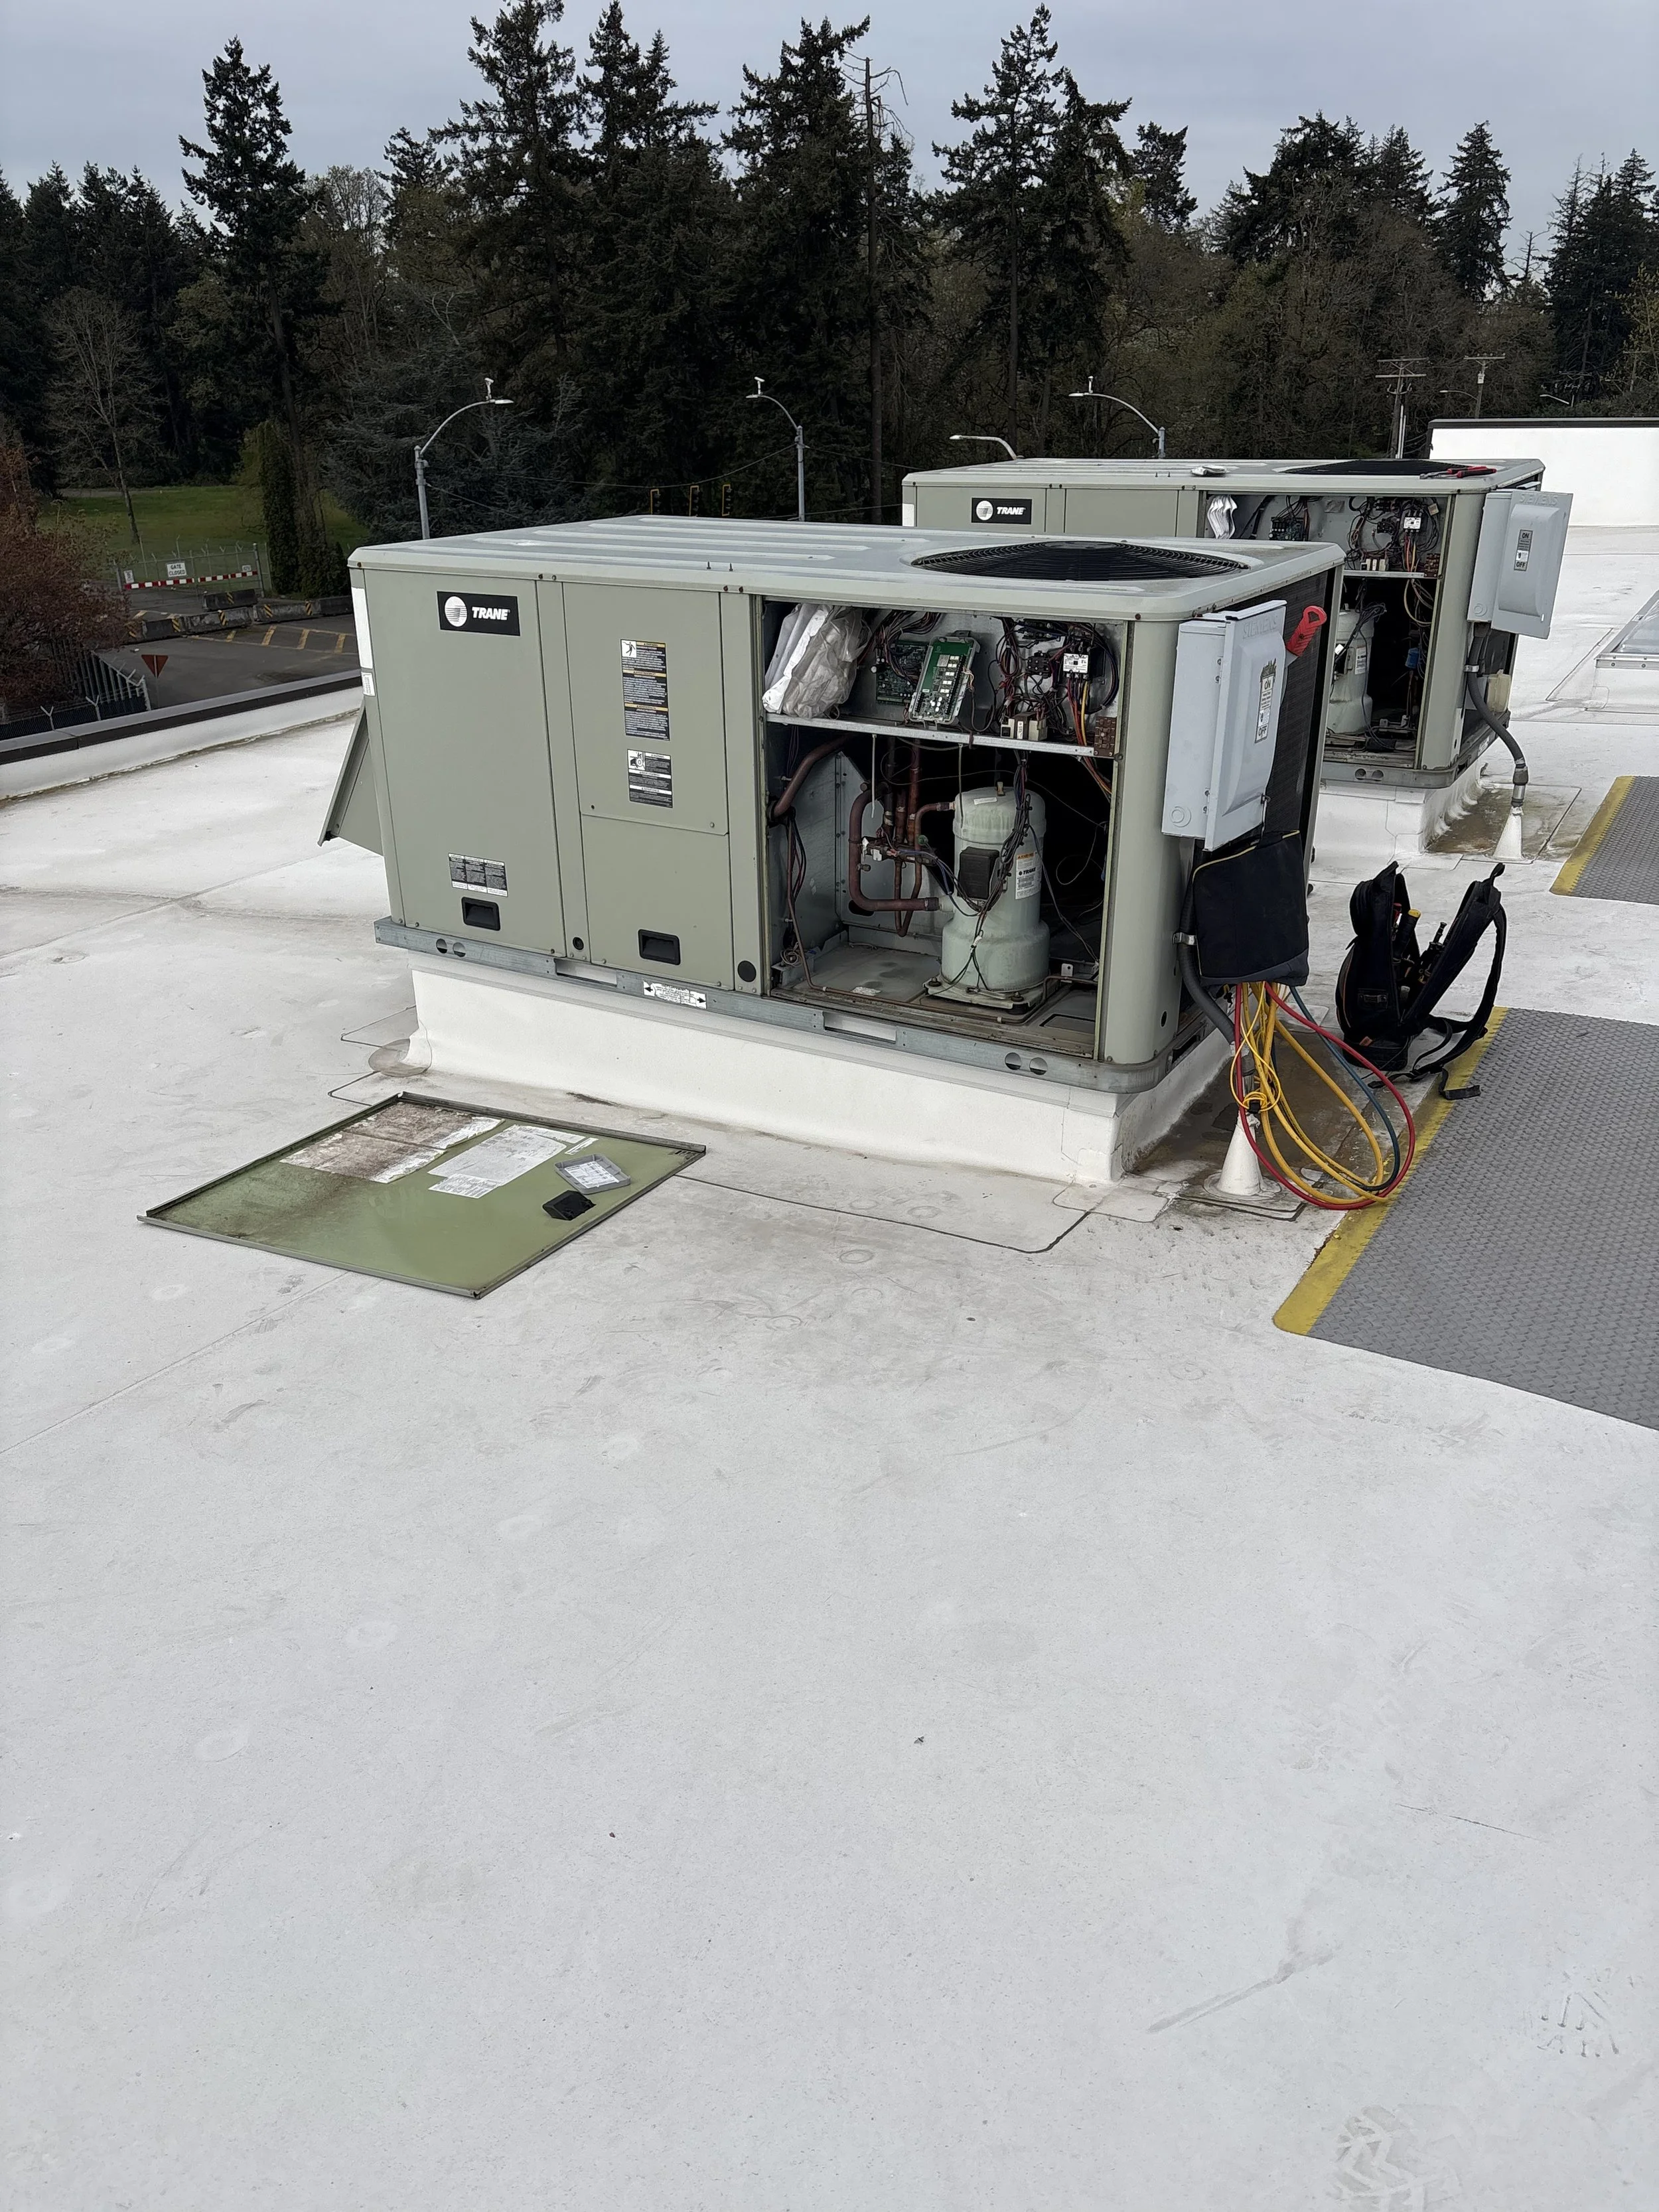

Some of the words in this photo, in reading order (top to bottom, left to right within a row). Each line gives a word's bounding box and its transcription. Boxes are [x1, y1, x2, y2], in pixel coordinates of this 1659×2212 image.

[997, 506, 1025, 515] TRANE
[472, 606, 509, 621] TRANE
[1264, 680, 1271, 690] ON
[1258, 726, 1268, 737] OFF
